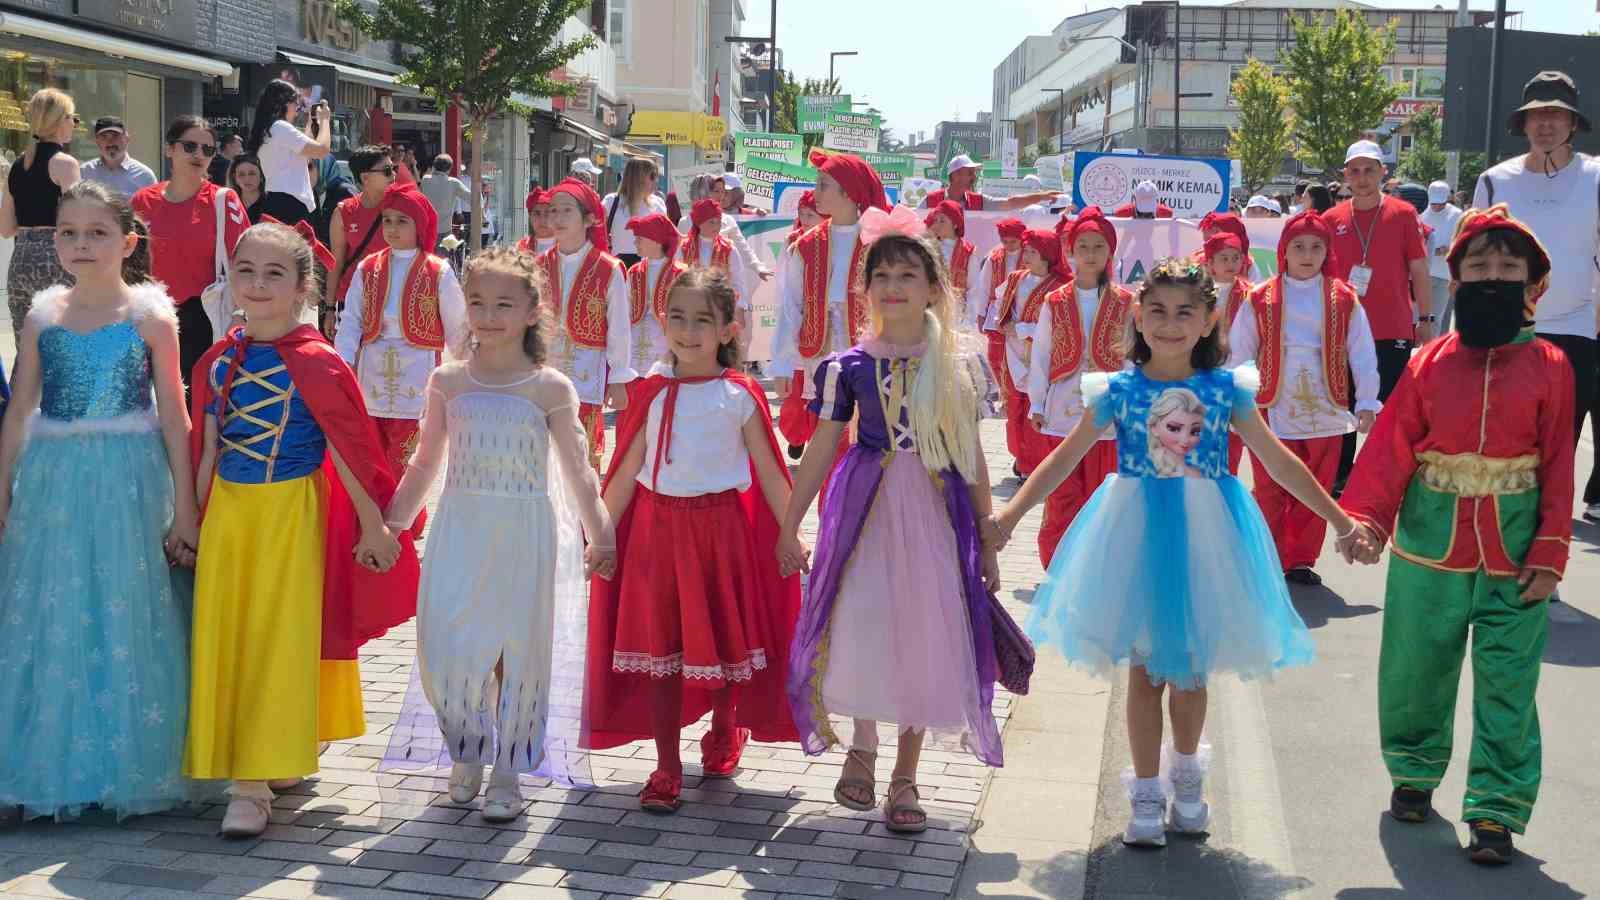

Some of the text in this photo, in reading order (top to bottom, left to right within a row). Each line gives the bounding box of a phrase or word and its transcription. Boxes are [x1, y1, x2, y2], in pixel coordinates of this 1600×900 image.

[1162, 168, 1191, 178] MERKEZ
[1131, 178, 1221, 195] NMIK KEMAL
